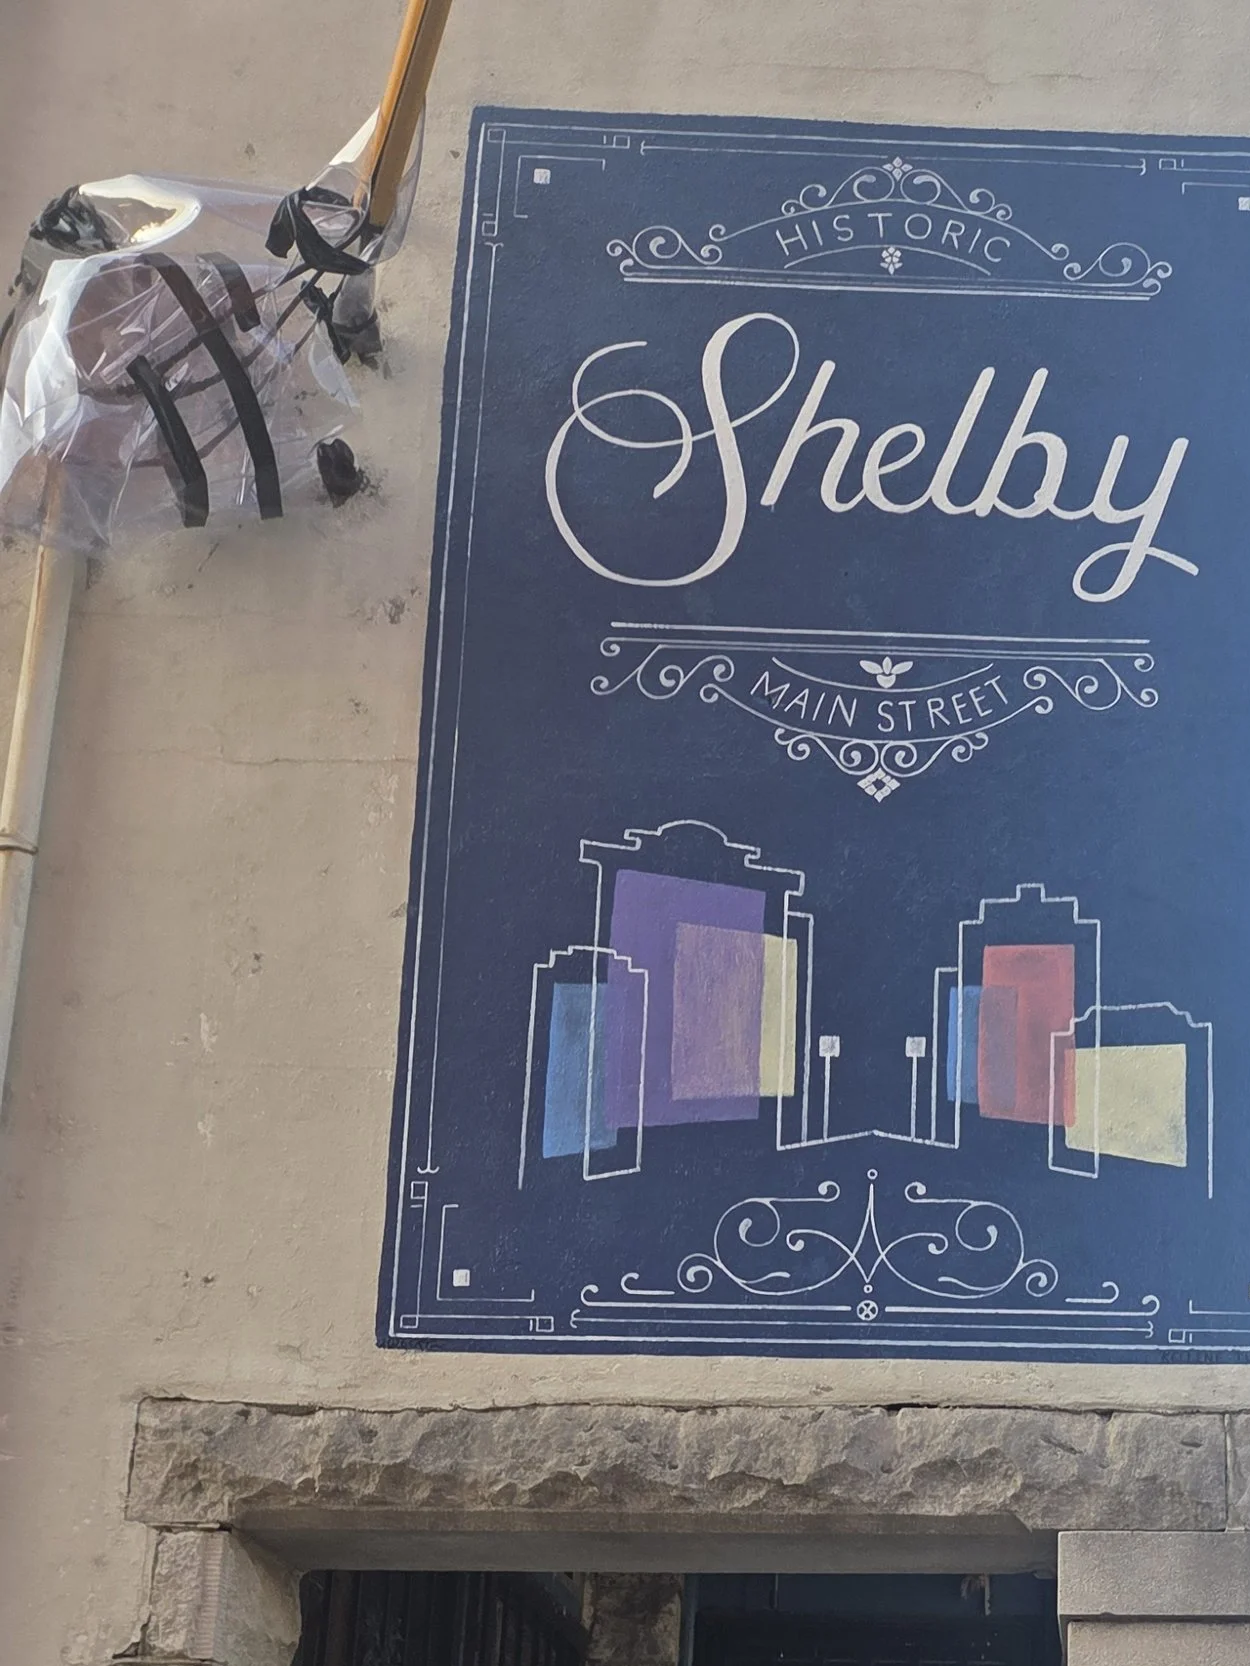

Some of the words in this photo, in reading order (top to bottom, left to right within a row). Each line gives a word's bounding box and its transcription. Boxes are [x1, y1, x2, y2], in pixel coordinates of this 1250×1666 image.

[776, 212, 1011, 263] HISTORIC
[545, 313, 1199, 602] Shelby
[750, 671, 858, 728] MAIN
[877, 675, 1009, 733] STREET
